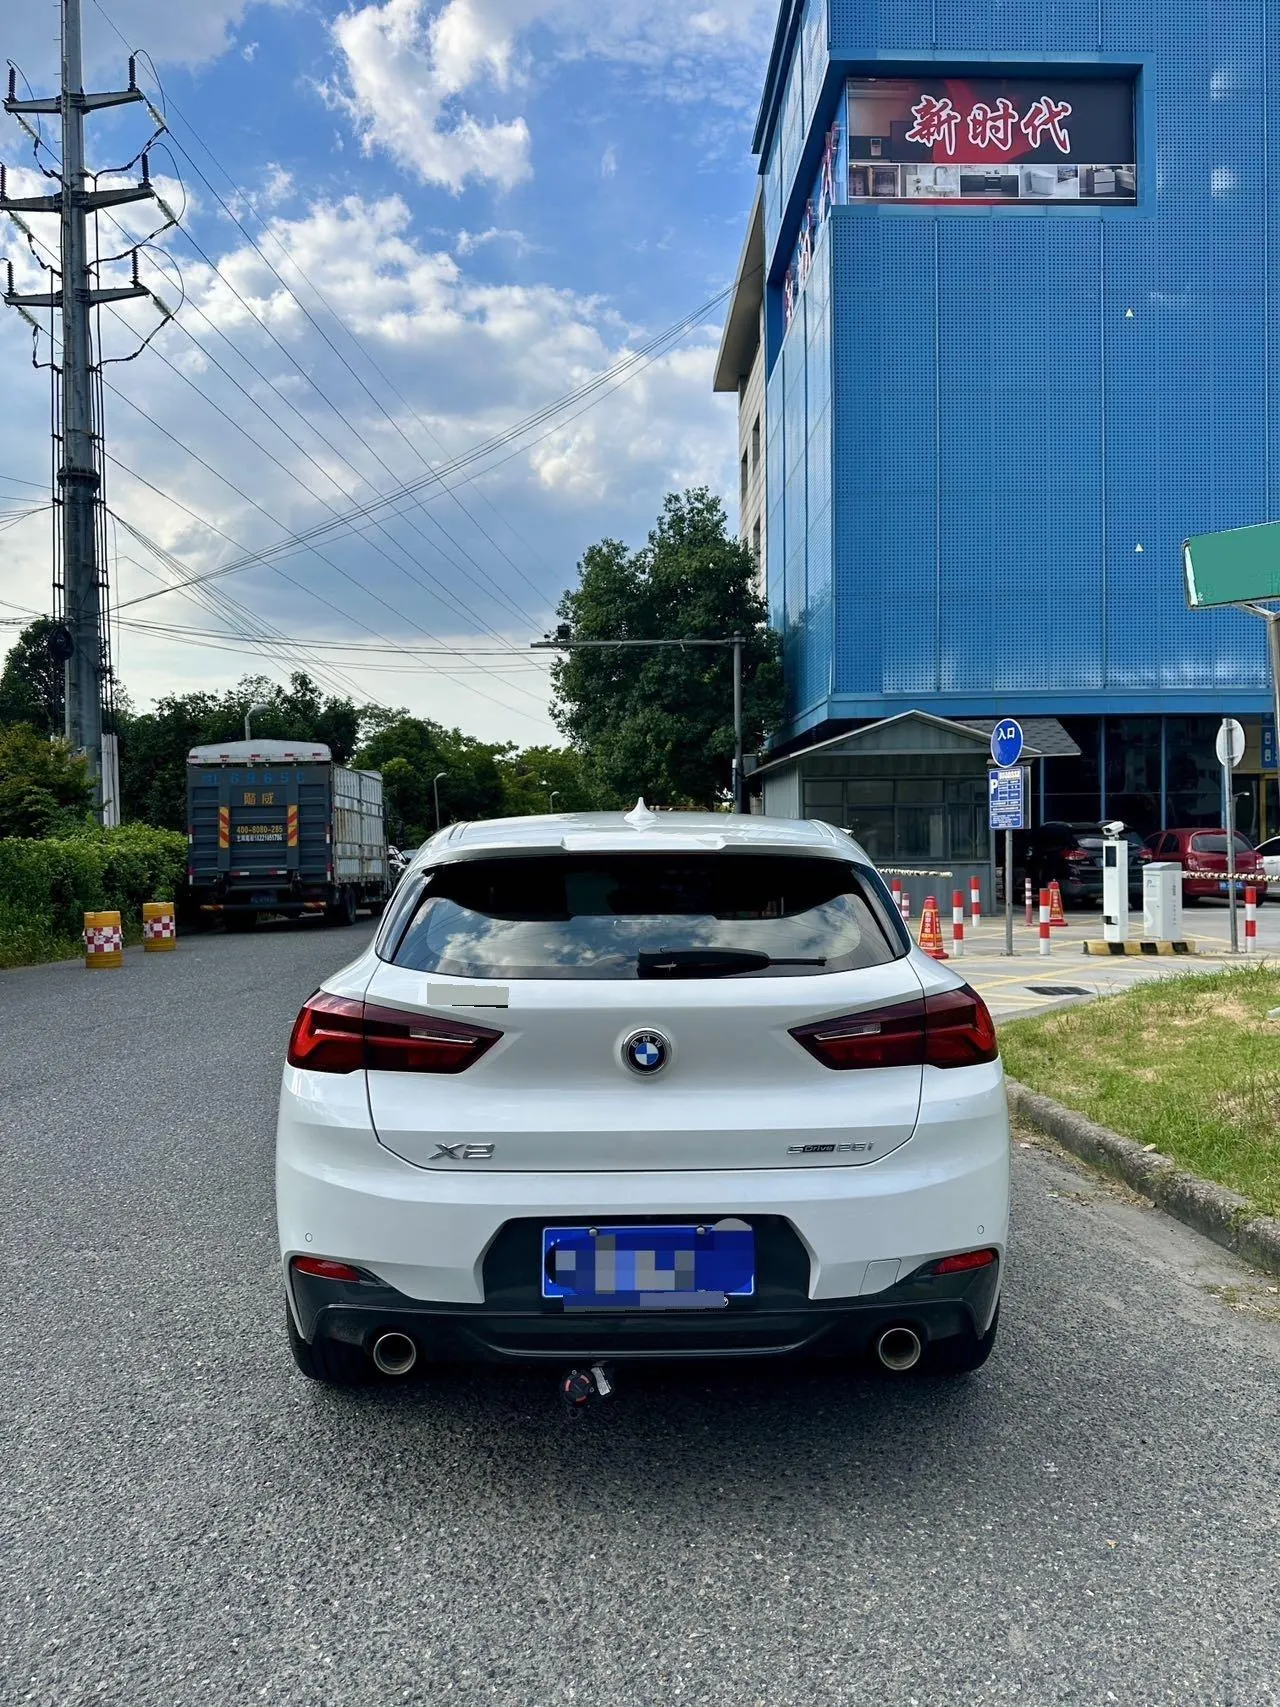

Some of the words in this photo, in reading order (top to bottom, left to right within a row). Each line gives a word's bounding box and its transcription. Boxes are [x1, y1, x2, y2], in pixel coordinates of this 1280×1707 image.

[905, 95, 1072, 155] 新时代
[997, 727, 1015, 741] 入口
[631, 1036, 663, 1048] BMW
[427, 1142, 496, 1160] X2
